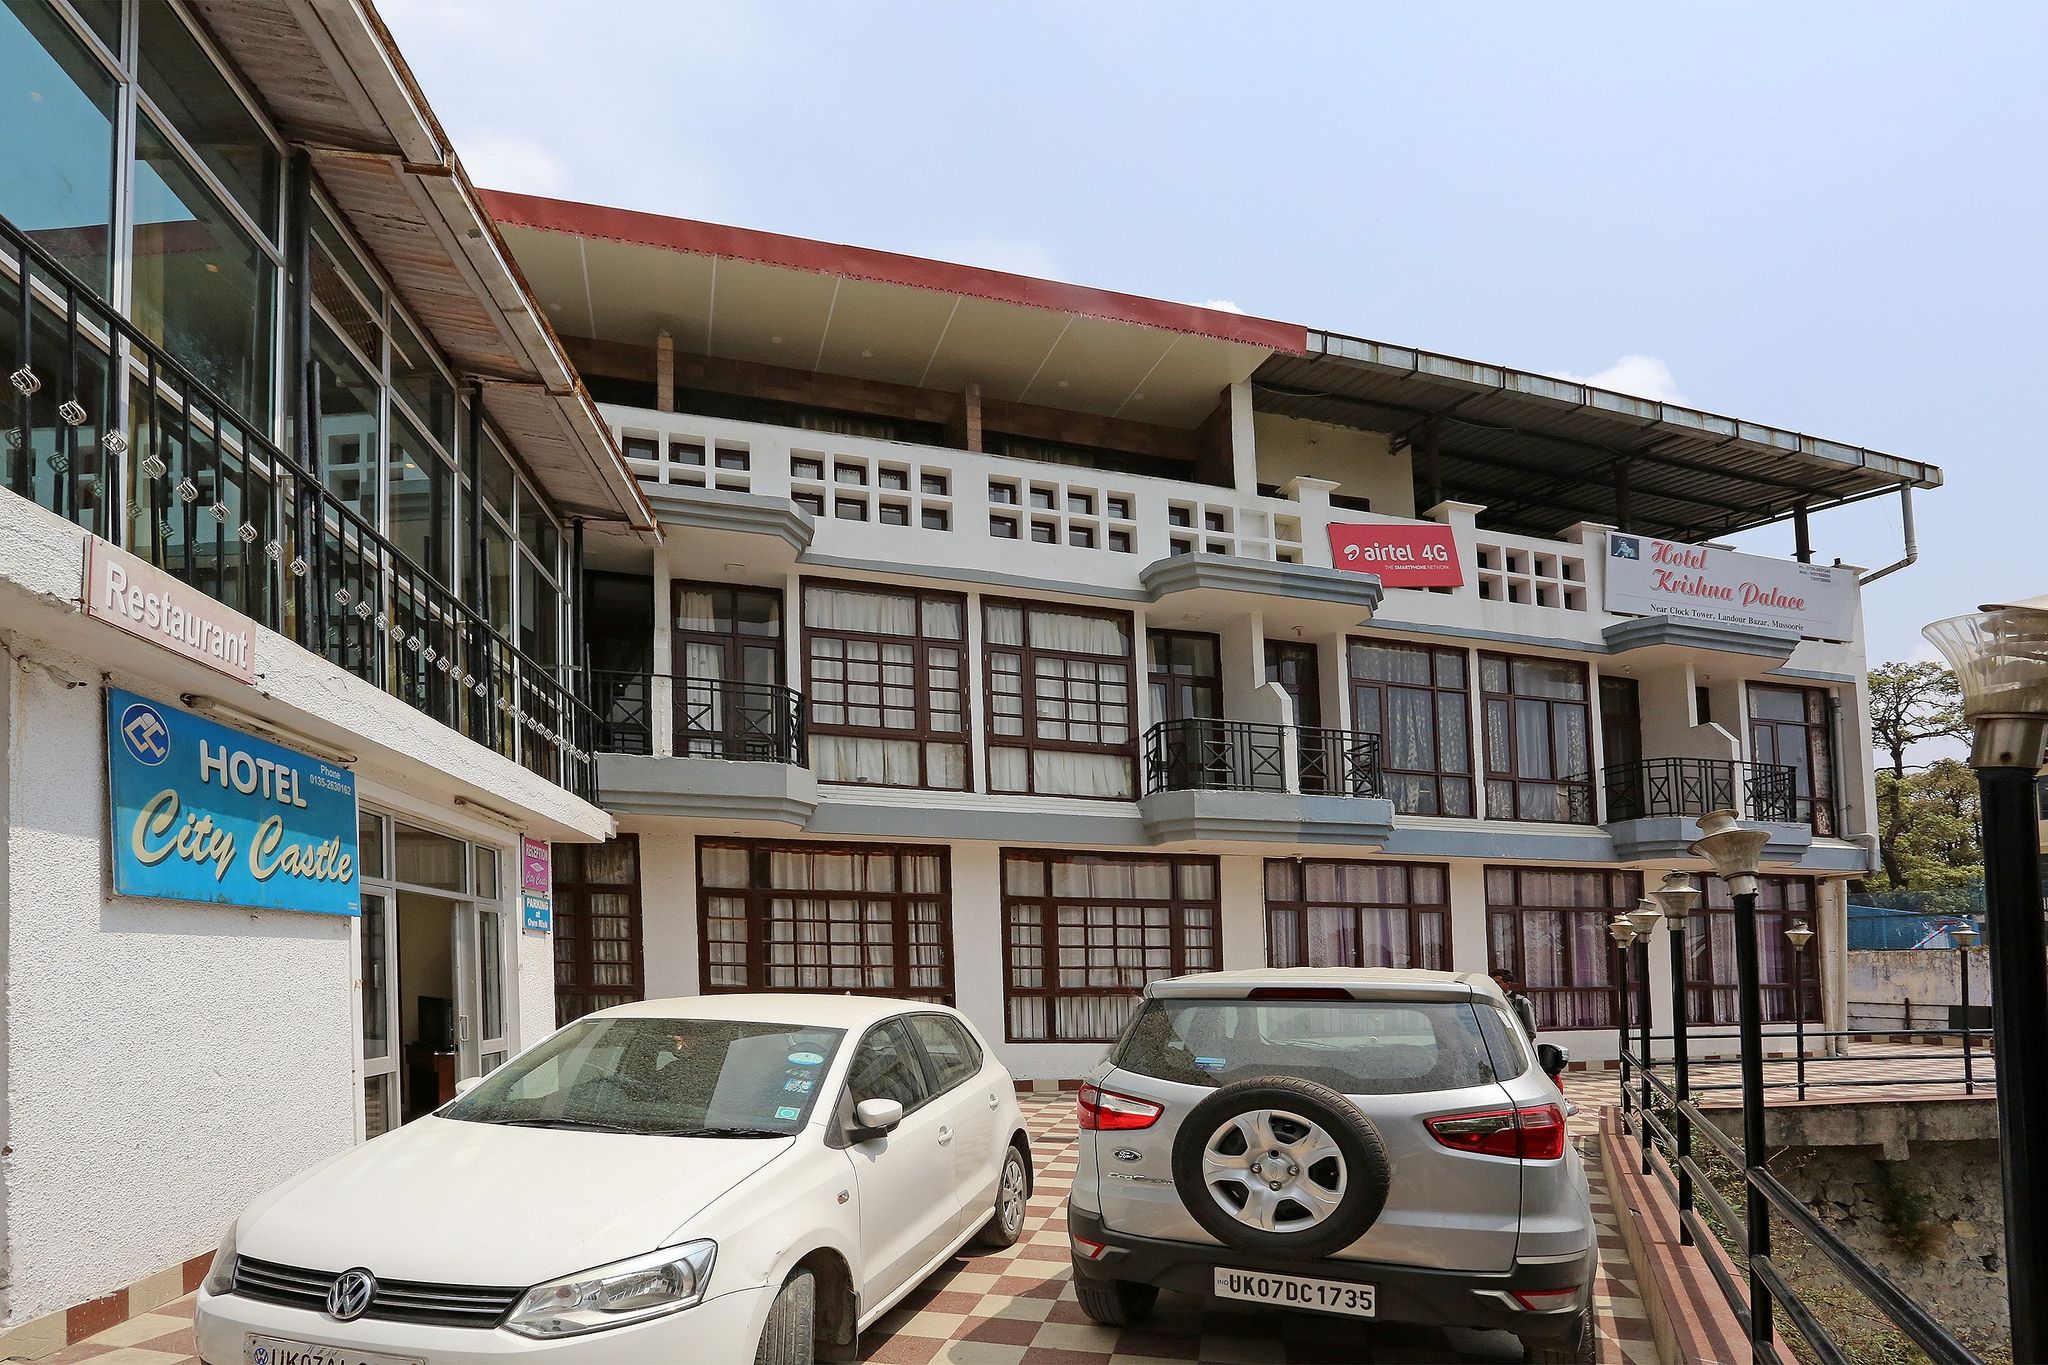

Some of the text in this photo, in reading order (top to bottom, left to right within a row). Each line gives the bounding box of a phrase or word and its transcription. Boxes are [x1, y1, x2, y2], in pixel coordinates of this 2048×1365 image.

[1364, 542, 1448, 561] airtel 4G
[1651, 541, 1708, 570] Hotel
[1650, 568, 1806, 611] Krishna Palace
[106, 560, 249, 669] Restaurant
[1650, 603, 1804, 632] Near Clock Tower, Landour Bazar, Mussoorie
[200, 738, 307, 807] HOTEL
[320, 764, 341, 780] Phone
[131, 788, 354, 885] City Castle
[526, 843, 548, 861] RECEPTION
[526, 897, 549, 911] PARKING
[535, 910, 541, 918] at
[527, 918, 548, 929] Own Risk
[1229, 1274, 1373, 1311] UK07DC1735
